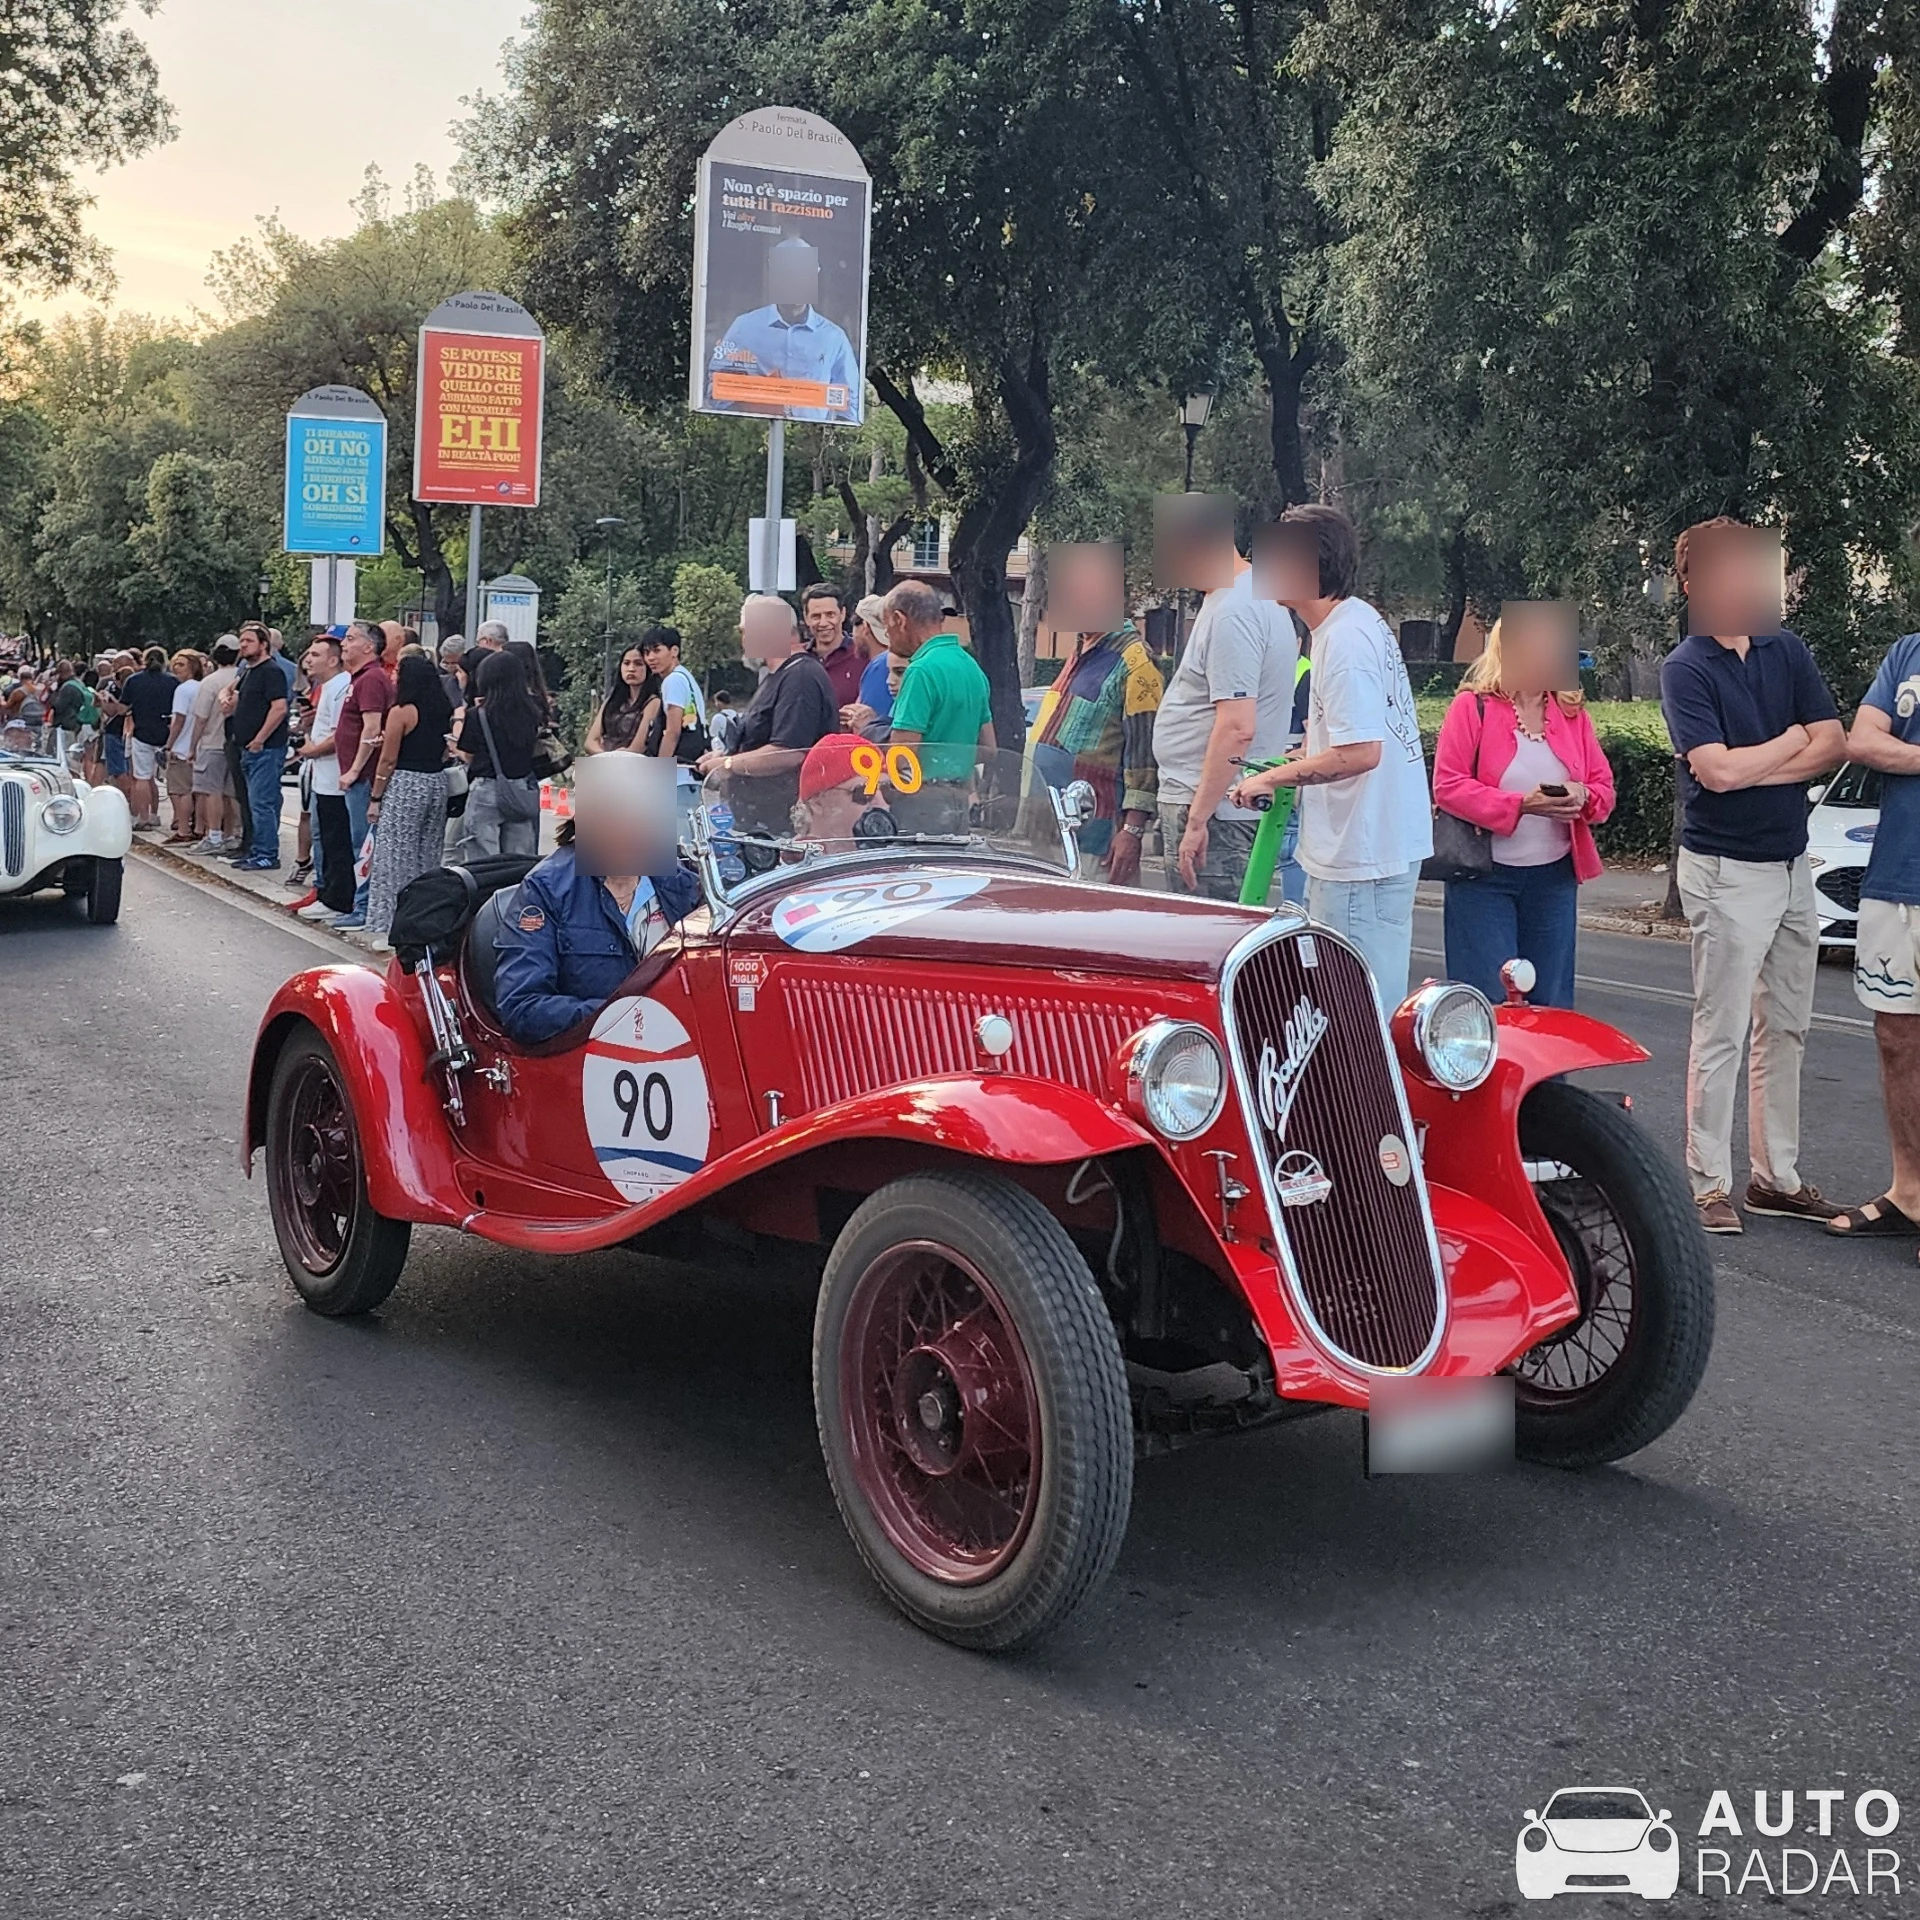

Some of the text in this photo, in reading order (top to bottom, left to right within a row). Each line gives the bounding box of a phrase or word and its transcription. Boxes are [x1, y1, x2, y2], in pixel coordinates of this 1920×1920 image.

[776, 113, 807, 125] fermata
[738, 119, 844, 145] S. Paolo Del Brasile
[723, 177, 753, 194] Non
[777, 188, 822, 203] spazio
[825, 194, 849, 207] per
[757, 197, 768, 211] il
[770, 201, 834, 219] razzismo
[455, 300, 478, 310] Paolo
[481, 303, 494, 312] Del
[496, 305, 524, 314] Brasile
[440, 346, 459, 360] SE
[461, 348, 523, 364] POTESSI
[439, 360, 522, 382] VEDERE
[439, 379, 522, 395] QUELLO CHE
[439, 392, 522, 406] ABBIAMO FATTO
[439, 403, 460, 413] CON
[305, 428, 316, 437] TI
[439, 413, 521, 452] EHI
[304, 438, 371, 457] OH NO
[438, 449, 521, 463] IN REALTÀ PUOI!
[304, 455, 345, 466] ADESSO
[302, 482, 368, 504] OH SÌ
[850, 745, 922, 795] 90
[832, 882, 932, 912] 90
[734, 962, 758, 972] 1000
[732, 974, 759, 984] MIGLIA
[1258, 994, 1328, 1142] Balilla
[613, 1069, 673, 1141] 90
